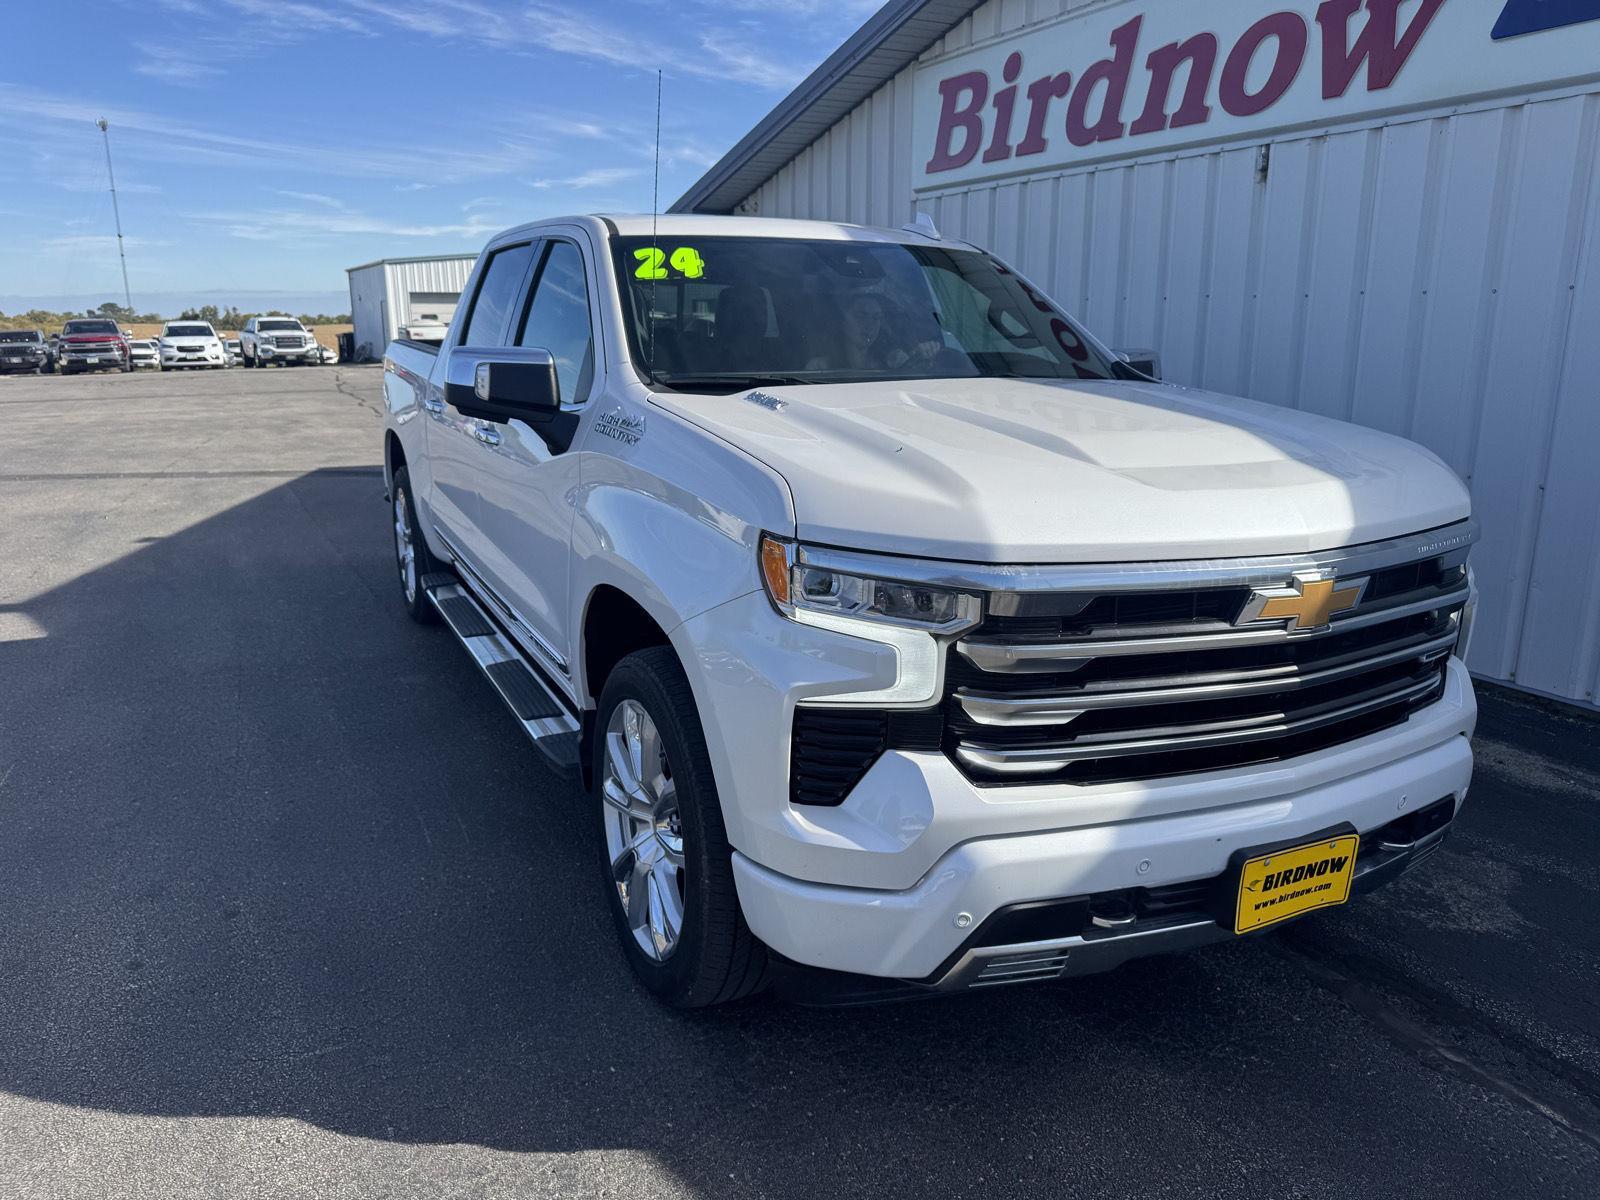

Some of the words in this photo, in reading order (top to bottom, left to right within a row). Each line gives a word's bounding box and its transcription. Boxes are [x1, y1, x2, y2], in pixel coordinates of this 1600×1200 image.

[925, 0, 1446, 174] Birdnow
[633, 247, 705, 280] 24
[1262, 856, 1349, 893] BIRDNOW
[1253, 882, 1332, 911] www.birdnow.com
